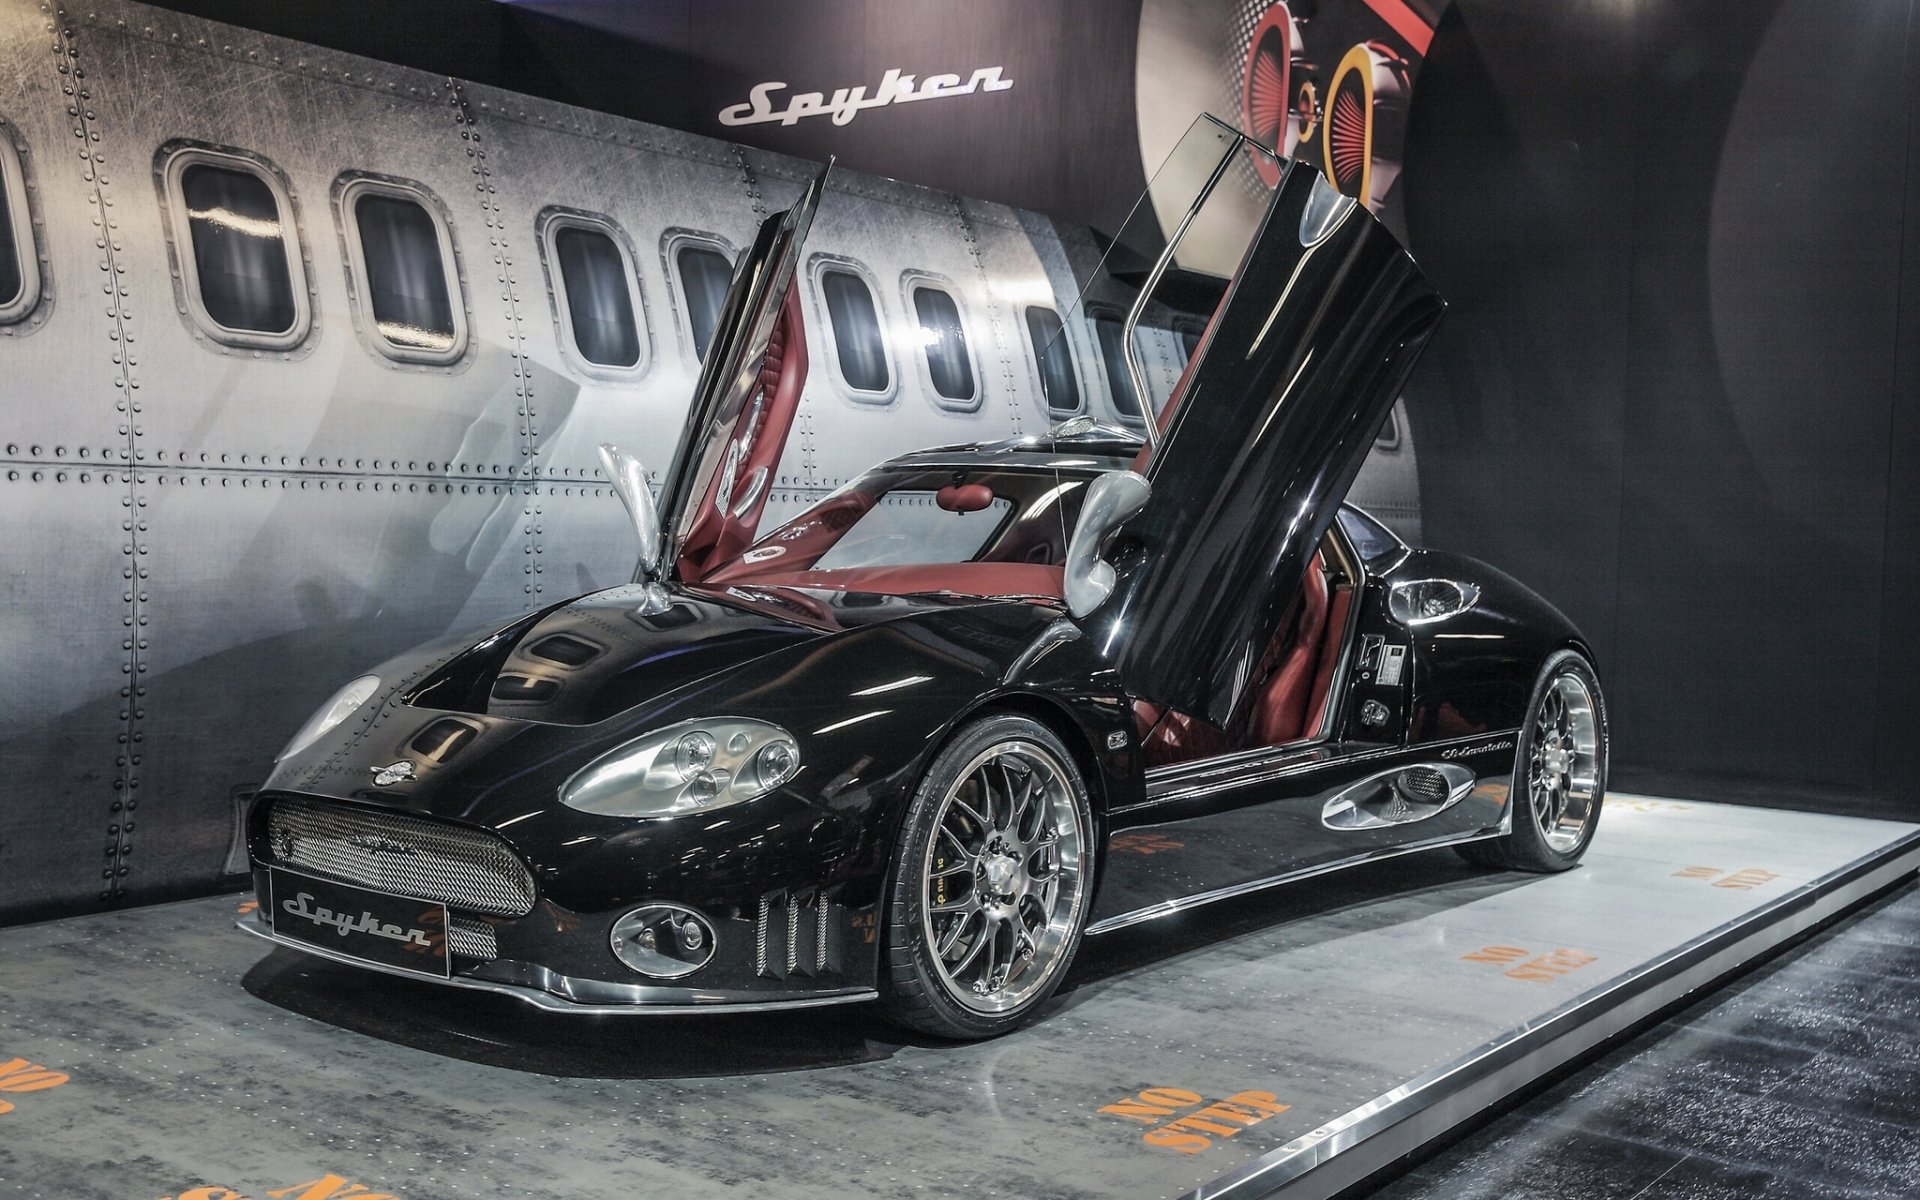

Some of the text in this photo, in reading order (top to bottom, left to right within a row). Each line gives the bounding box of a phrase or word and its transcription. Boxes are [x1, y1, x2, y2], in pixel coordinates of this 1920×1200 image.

[718, 66, 1014, 126] Spyker
[282, 892, 431, 947] Spyker
[1459, 945, 1530, 967] NO
[1097, 1087, 1202, 1125] NO
[1143, 1090, 1292, 1155] STEP
